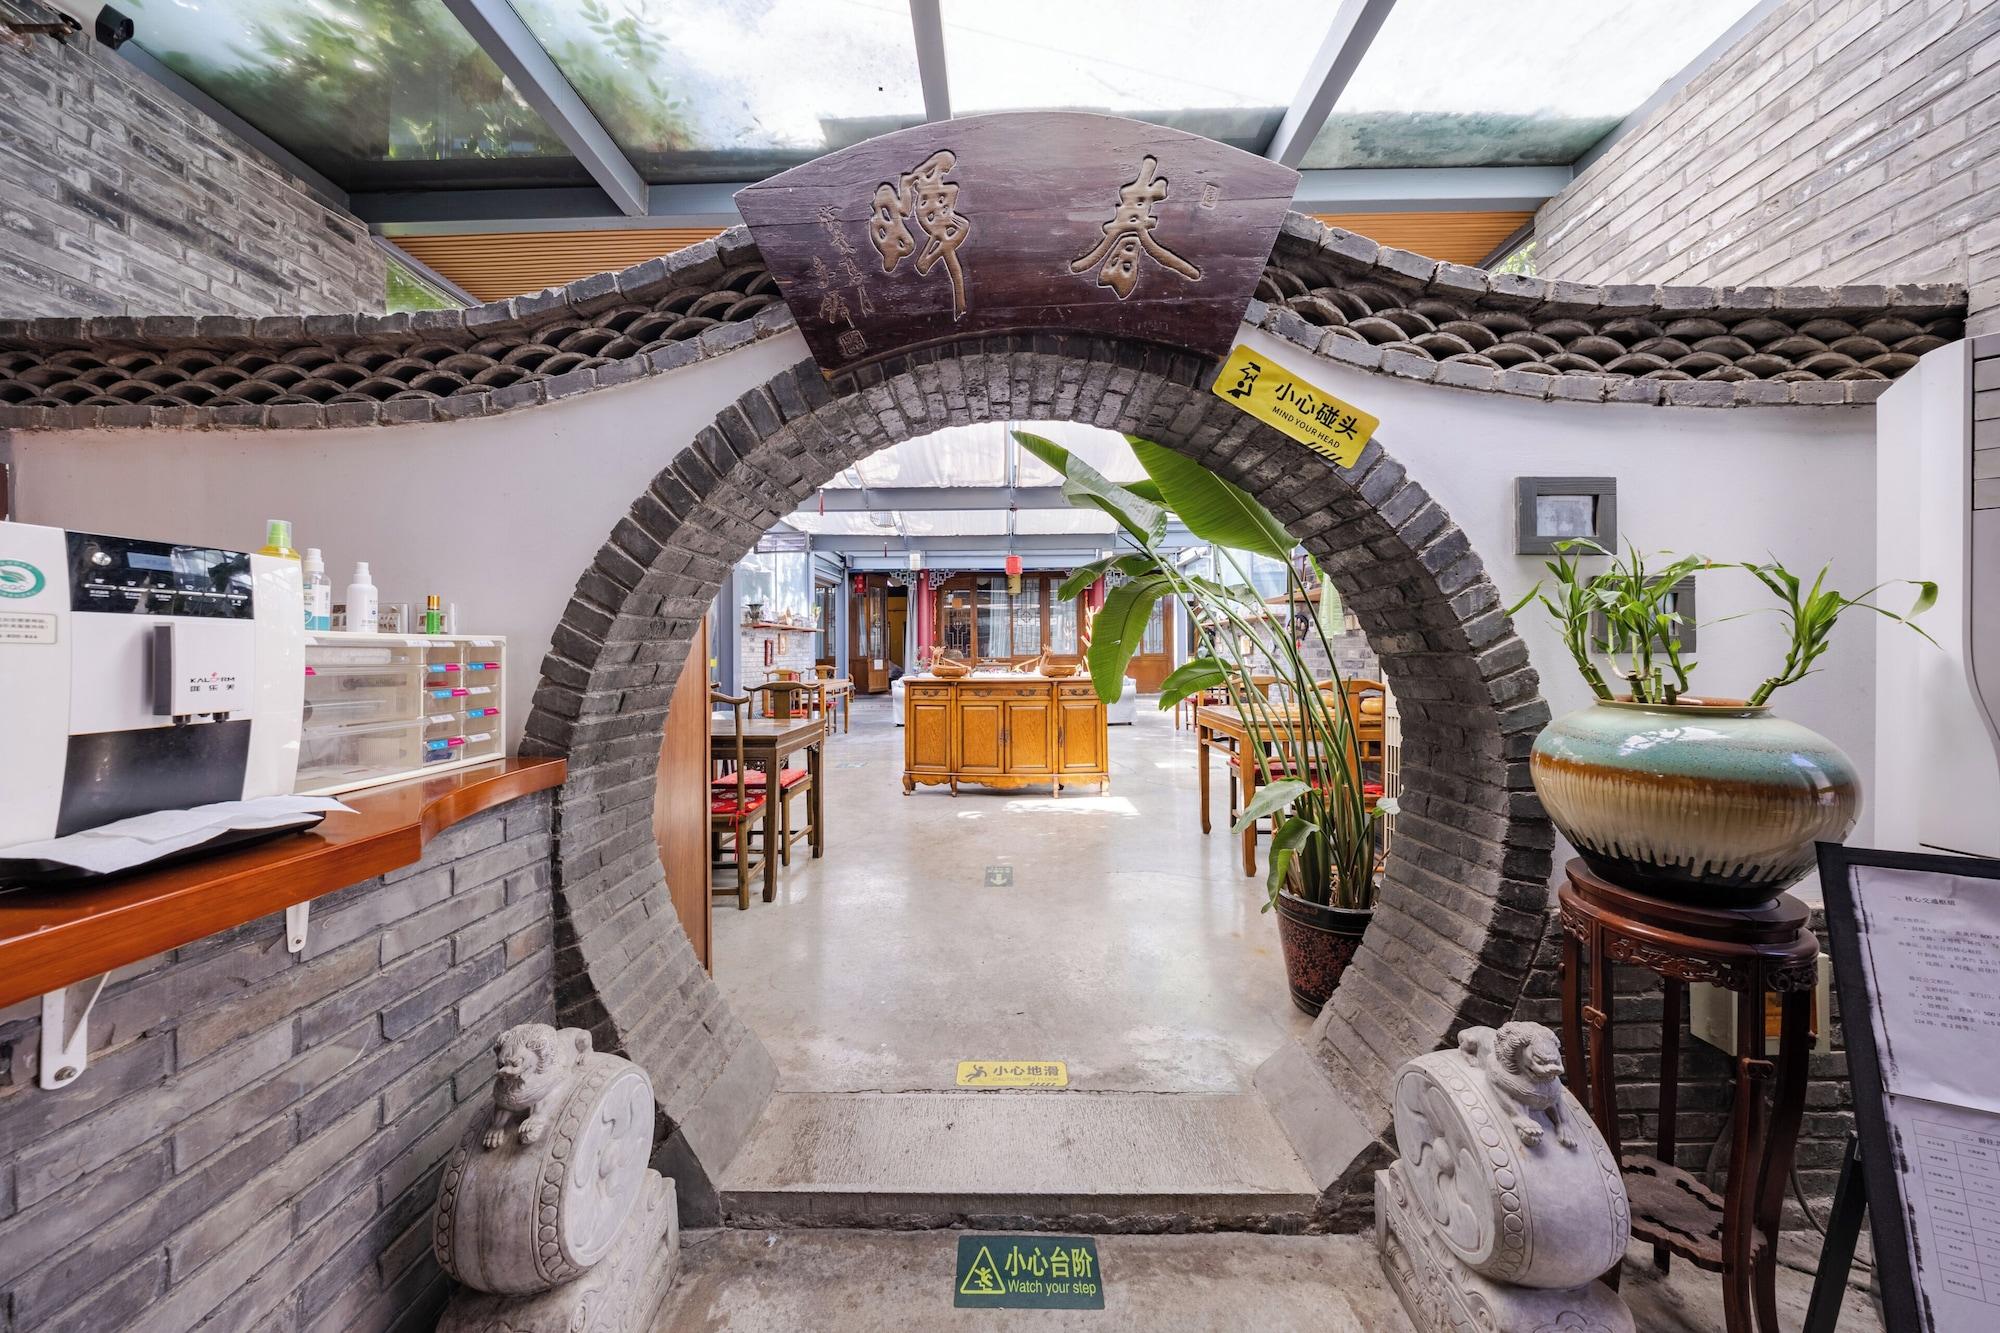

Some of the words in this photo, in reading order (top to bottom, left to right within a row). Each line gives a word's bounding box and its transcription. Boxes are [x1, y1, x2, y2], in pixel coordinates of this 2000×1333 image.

[1271, 405, 1295, 423] MIND
[1295, 418, 1318, 435] YOUR
[1317, 431, 1341, 449] HEAD
[1275, 382, 1358, 441] 小心碰头
[993, 1065, 1059, 1077] 小心地滑
[1004, 1245, 1094, 1278] 小心台阶
[1008, 1279, 1043, 1293] Watch
[1045, 1282, 1070, 1297] your
[1072, 1281, 1097, 1298] step
